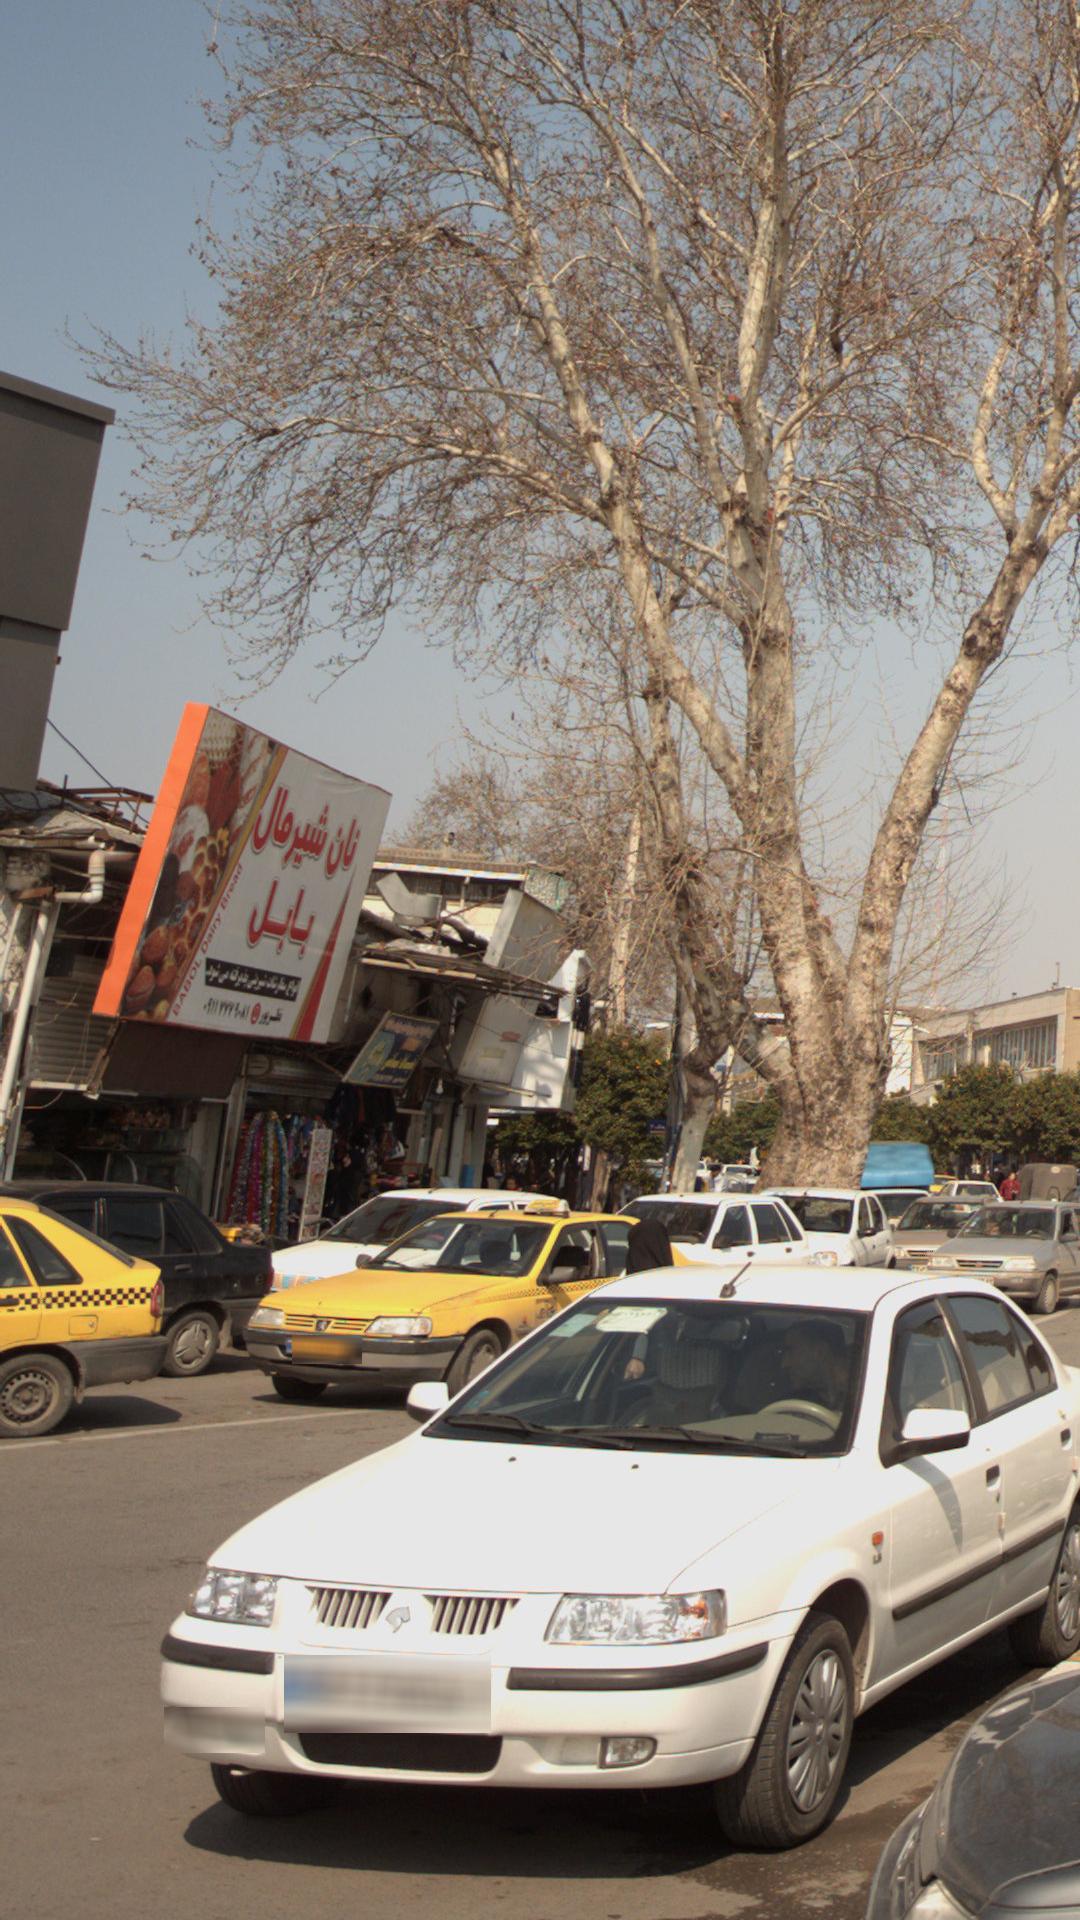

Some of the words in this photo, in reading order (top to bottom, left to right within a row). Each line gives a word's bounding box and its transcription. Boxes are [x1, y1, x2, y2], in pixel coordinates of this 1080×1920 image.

[253, 786, 329, 868] شیرمال
[326, 819, 360, 877] نان
[172, 959, 201, 1017] BABOL
[201, 911, 223, 955] Dairy
[220, 863, 244, 911] Bread
[248, 879, 315, 958] بابل
